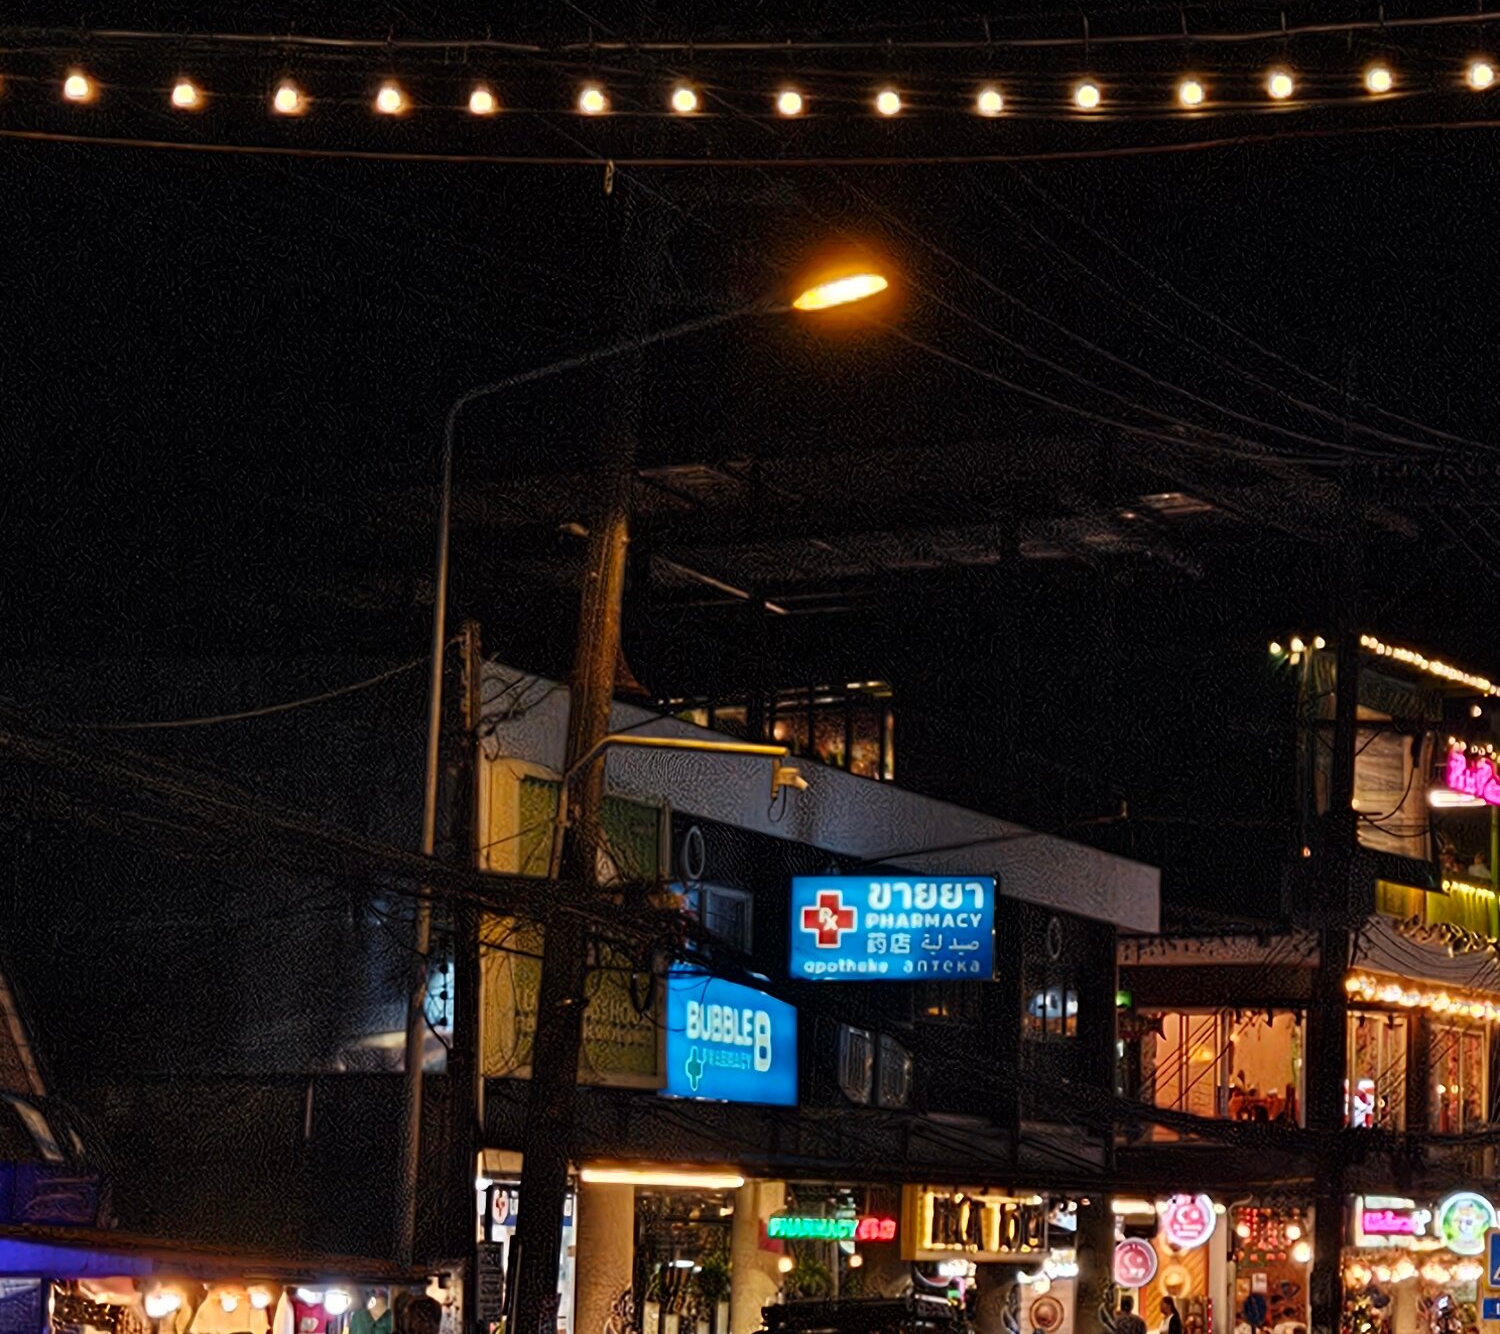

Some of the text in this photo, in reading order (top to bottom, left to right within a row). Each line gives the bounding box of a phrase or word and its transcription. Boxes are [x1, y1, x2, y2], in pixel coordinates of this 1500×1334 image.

[867, 881, 985, 910] ขายยา
[865, 912, 983, 929] PHARMACY
[686, 1000, 754, 1046] BUBBLE
